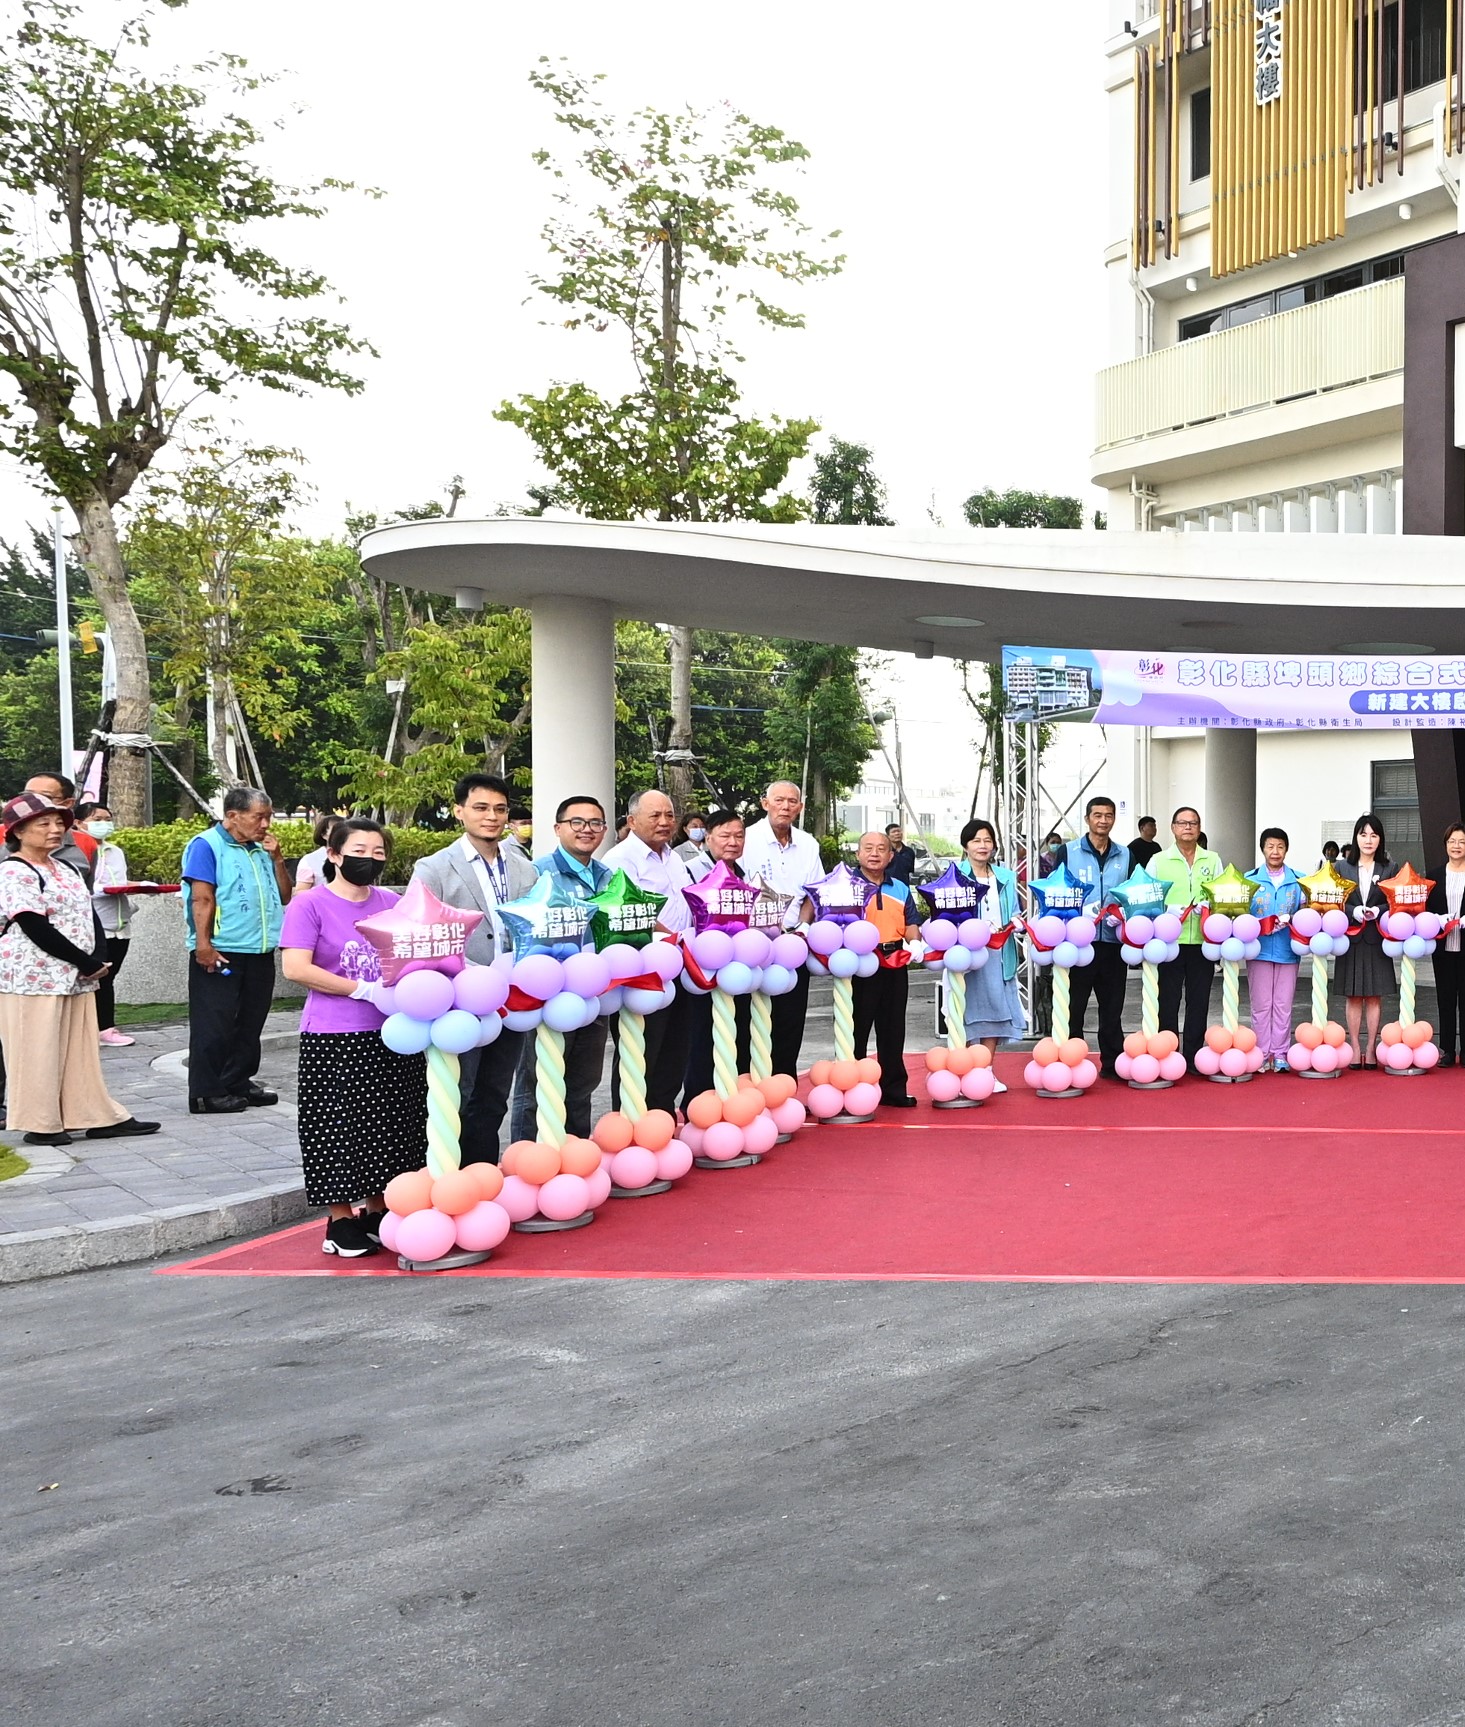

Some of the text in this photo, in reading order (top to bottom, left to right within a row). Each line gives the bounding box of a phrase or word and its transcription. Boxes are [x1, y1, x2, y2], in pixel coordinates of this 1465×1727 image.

[935, 898, 976, 908] 希望城市
[393, 940, 464, 959] 希望城市
